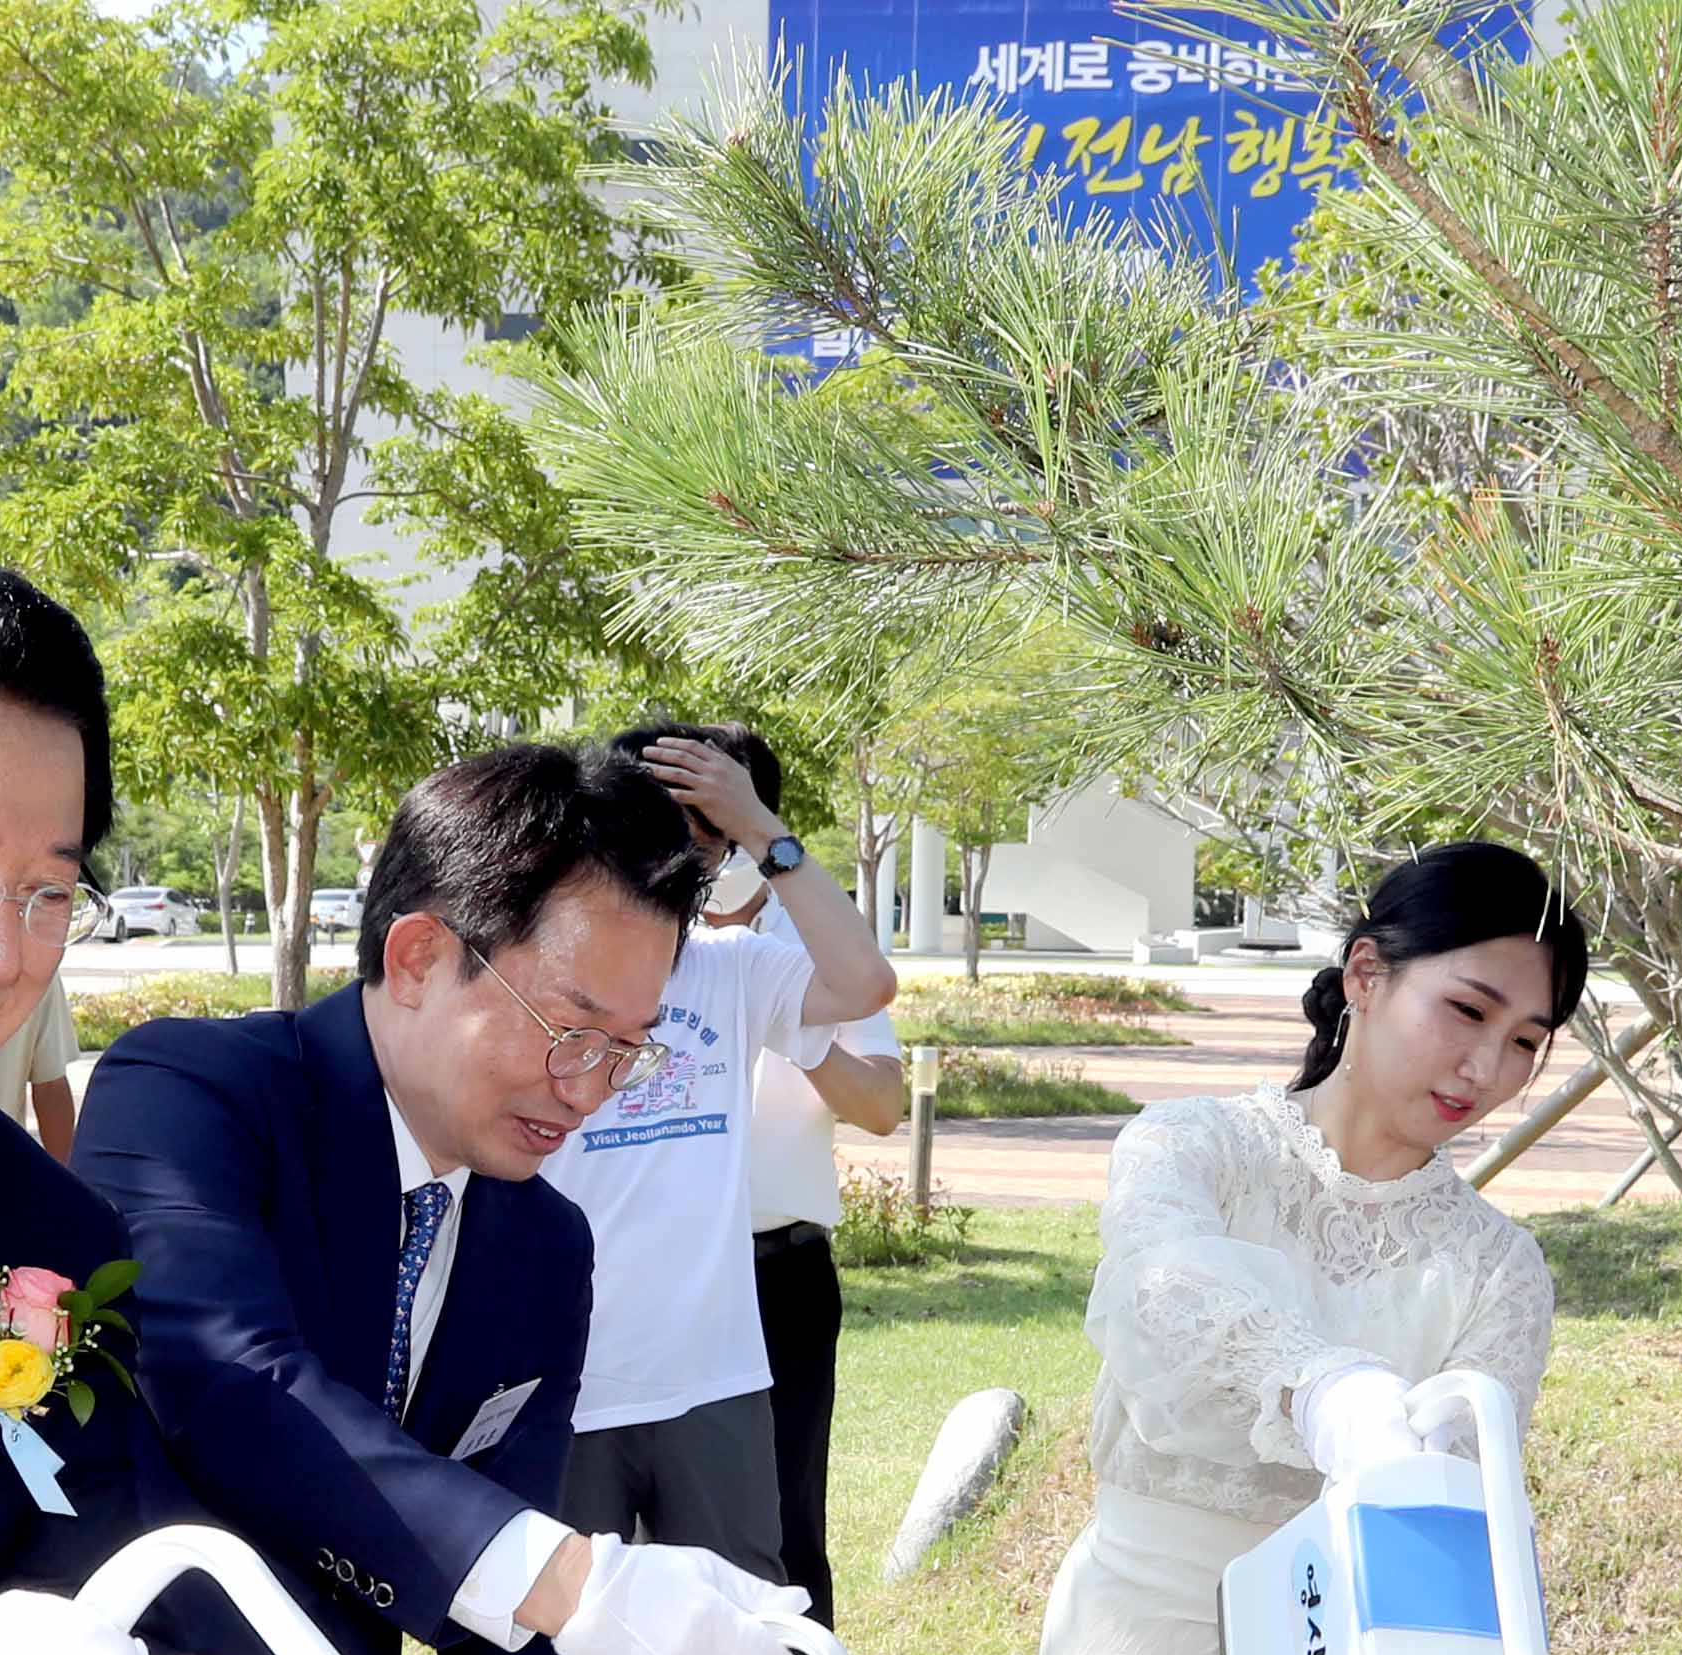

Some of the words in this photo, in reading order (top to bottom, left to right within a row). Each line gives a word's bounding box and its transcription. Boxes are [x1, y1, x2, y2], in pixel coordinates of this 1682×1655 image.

[968, 41, 1113, 93] 세계로
[1127, 39, 1317, 93] 웅비하는
[1062, 115, 1212, 196] 전남
[701, 1061, 727, 1076] 2023
[590, 1132, 621, 1146] Visit
[623, 1121, 697, 1142] Jeollanamdo
[698, 1117, 723, 1130] Year
